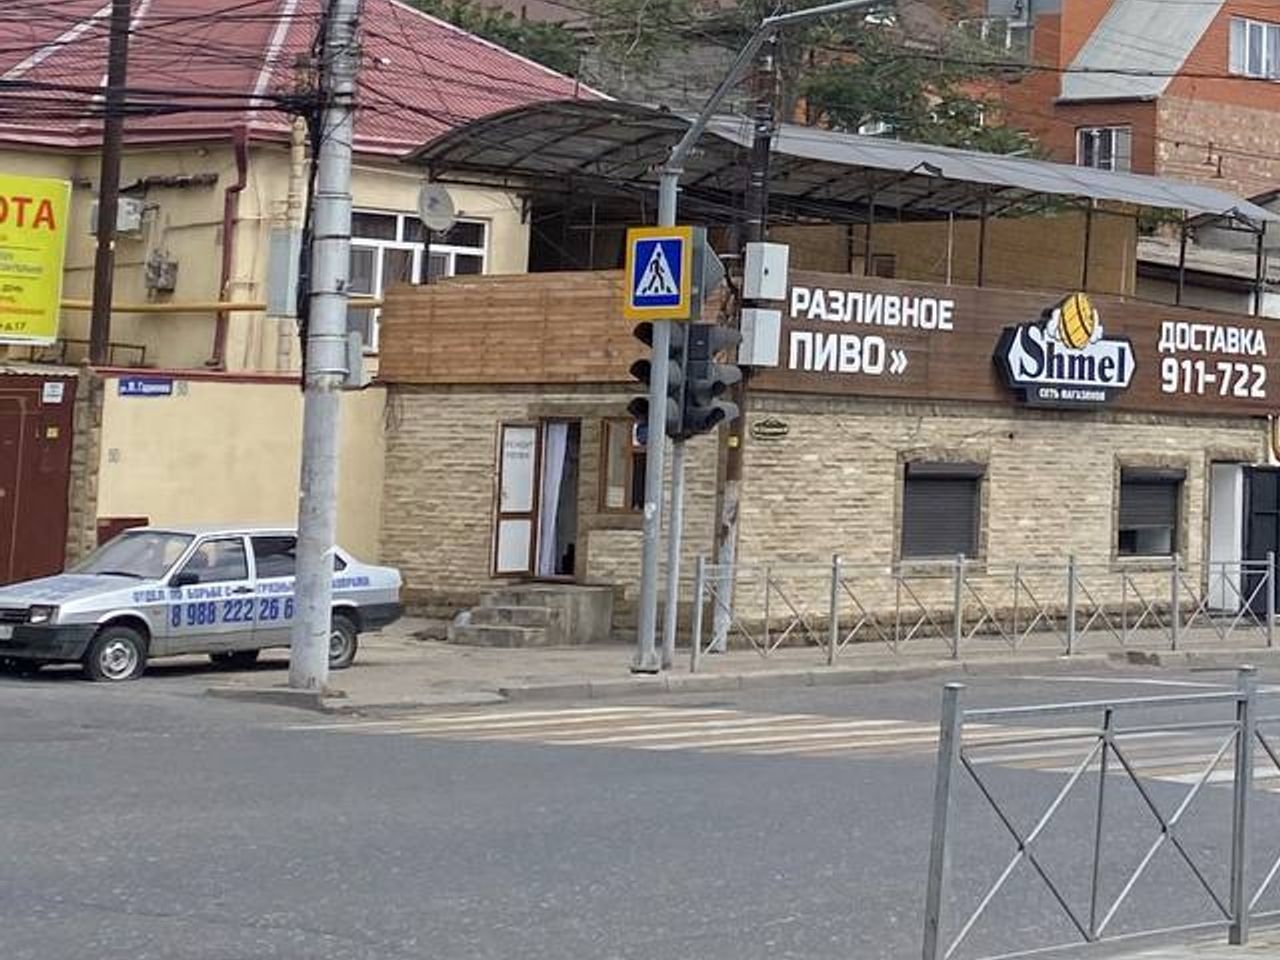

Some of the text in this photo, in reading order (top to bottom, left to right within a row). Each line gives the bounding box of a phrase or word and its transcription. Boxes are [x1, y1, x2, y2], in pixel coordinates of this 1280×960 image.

[790, 287, 955, 330] РАЗЛИВНОЕ
[1018, 324, 1127, 385] Shmel
[1158, 321, 1267, 356] ДОСТАВКА
[1038, 387, 1060, 399] СЕТЬ
[1161, 357, 1267, 398] 911-722
[171, 604, 182, 628] 8
[186, 602, 216, 626] 988
[223, 598, 255, 623] 222
[259, 598, 279, 621] 26
